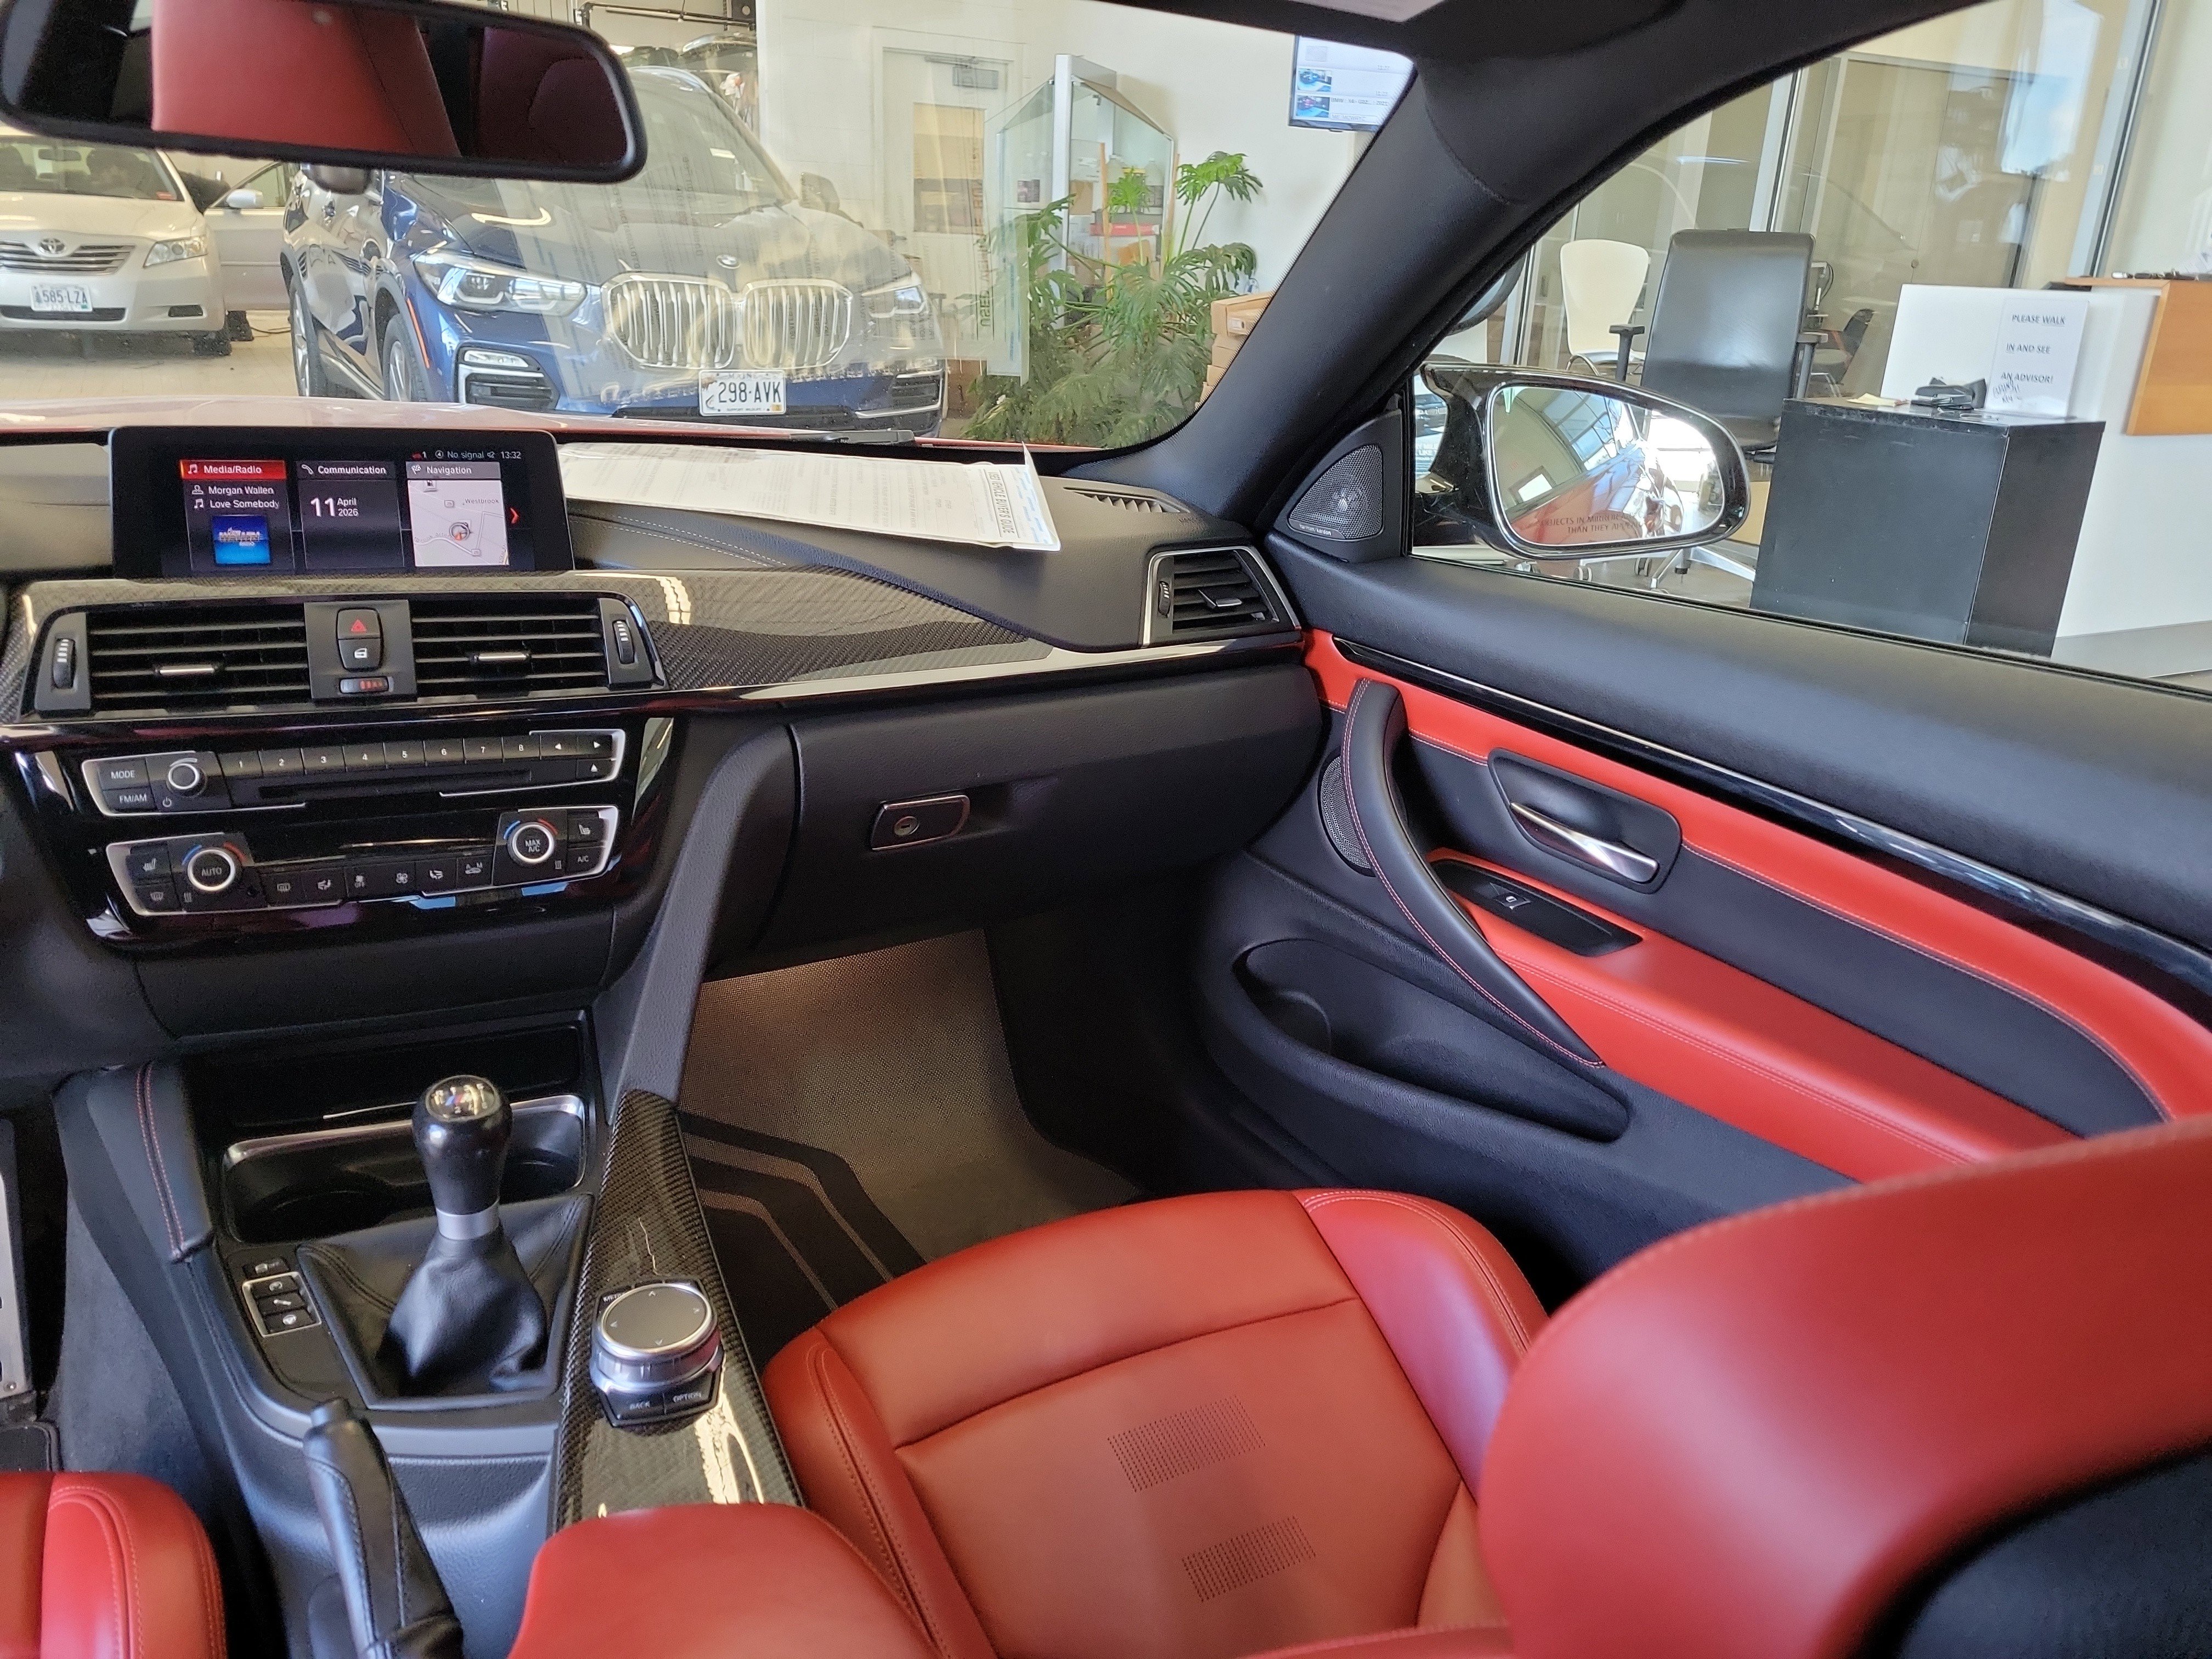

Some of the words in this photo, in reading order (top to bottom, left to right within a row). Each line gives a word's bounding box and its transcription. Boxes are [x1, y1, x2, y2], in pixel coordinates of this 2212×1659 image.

[2012, 314, 2040, 324] PLEASE
[2041, 315, 2066, 325] WALK
[2006, 342, 2015, 352] IN
[2017, 343, 2034, 353] AND
[2036, 345, 2051, 354] SEE
[2001, 372, 2012, 381] AN
[2015, 373, 2053, 383] ADVISOR!
[461, 451, 484, 460] signal
[204, 465, 262, 473] Media/Radio
[318, 466, 387, 474] Communication
[427, 466, 472, 475] Navigation
[208, 486, 242, 496] Morgan
[245, 486, 274, 494] Wallen
[210, 500, 231, 508] Love
[233, 499, 279, 509] Somebody
[311, 498, 336, 517] 11
[337, 497, 357, 507] April
[338, 509, 359, 517] 2026
[1587, 514, 1618, 523] MIRROR
[1000, 519, 1015, 534] GUIDE
[1568, 526, 1588, 534] THAN
[111, 770, 136, 780] MODE
[119, 793, 147, 803] FM/AM
[525, 839, 541, 848] MAX
[577, 855, 589, 864] A/C
[201, 866, 223, 877] AUTO
[673, 1392, 702, 1403] OPTION
